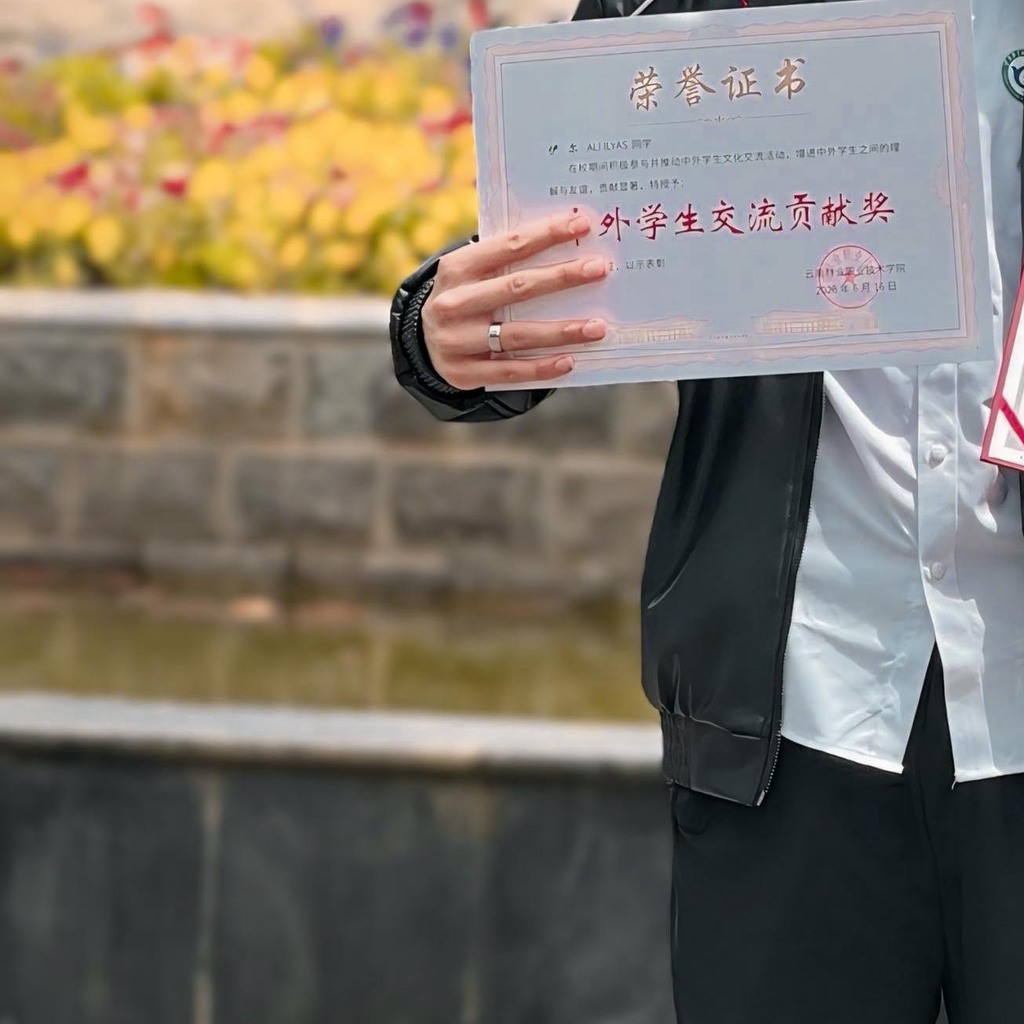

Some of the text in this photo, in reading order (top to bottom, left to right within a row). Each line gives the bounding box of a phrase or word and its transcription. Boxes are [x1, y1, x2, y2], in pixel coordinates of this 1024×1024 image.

[628, 57, 807, 112] 荣誉证书
[603, 140, 628, 151] ILYAS
